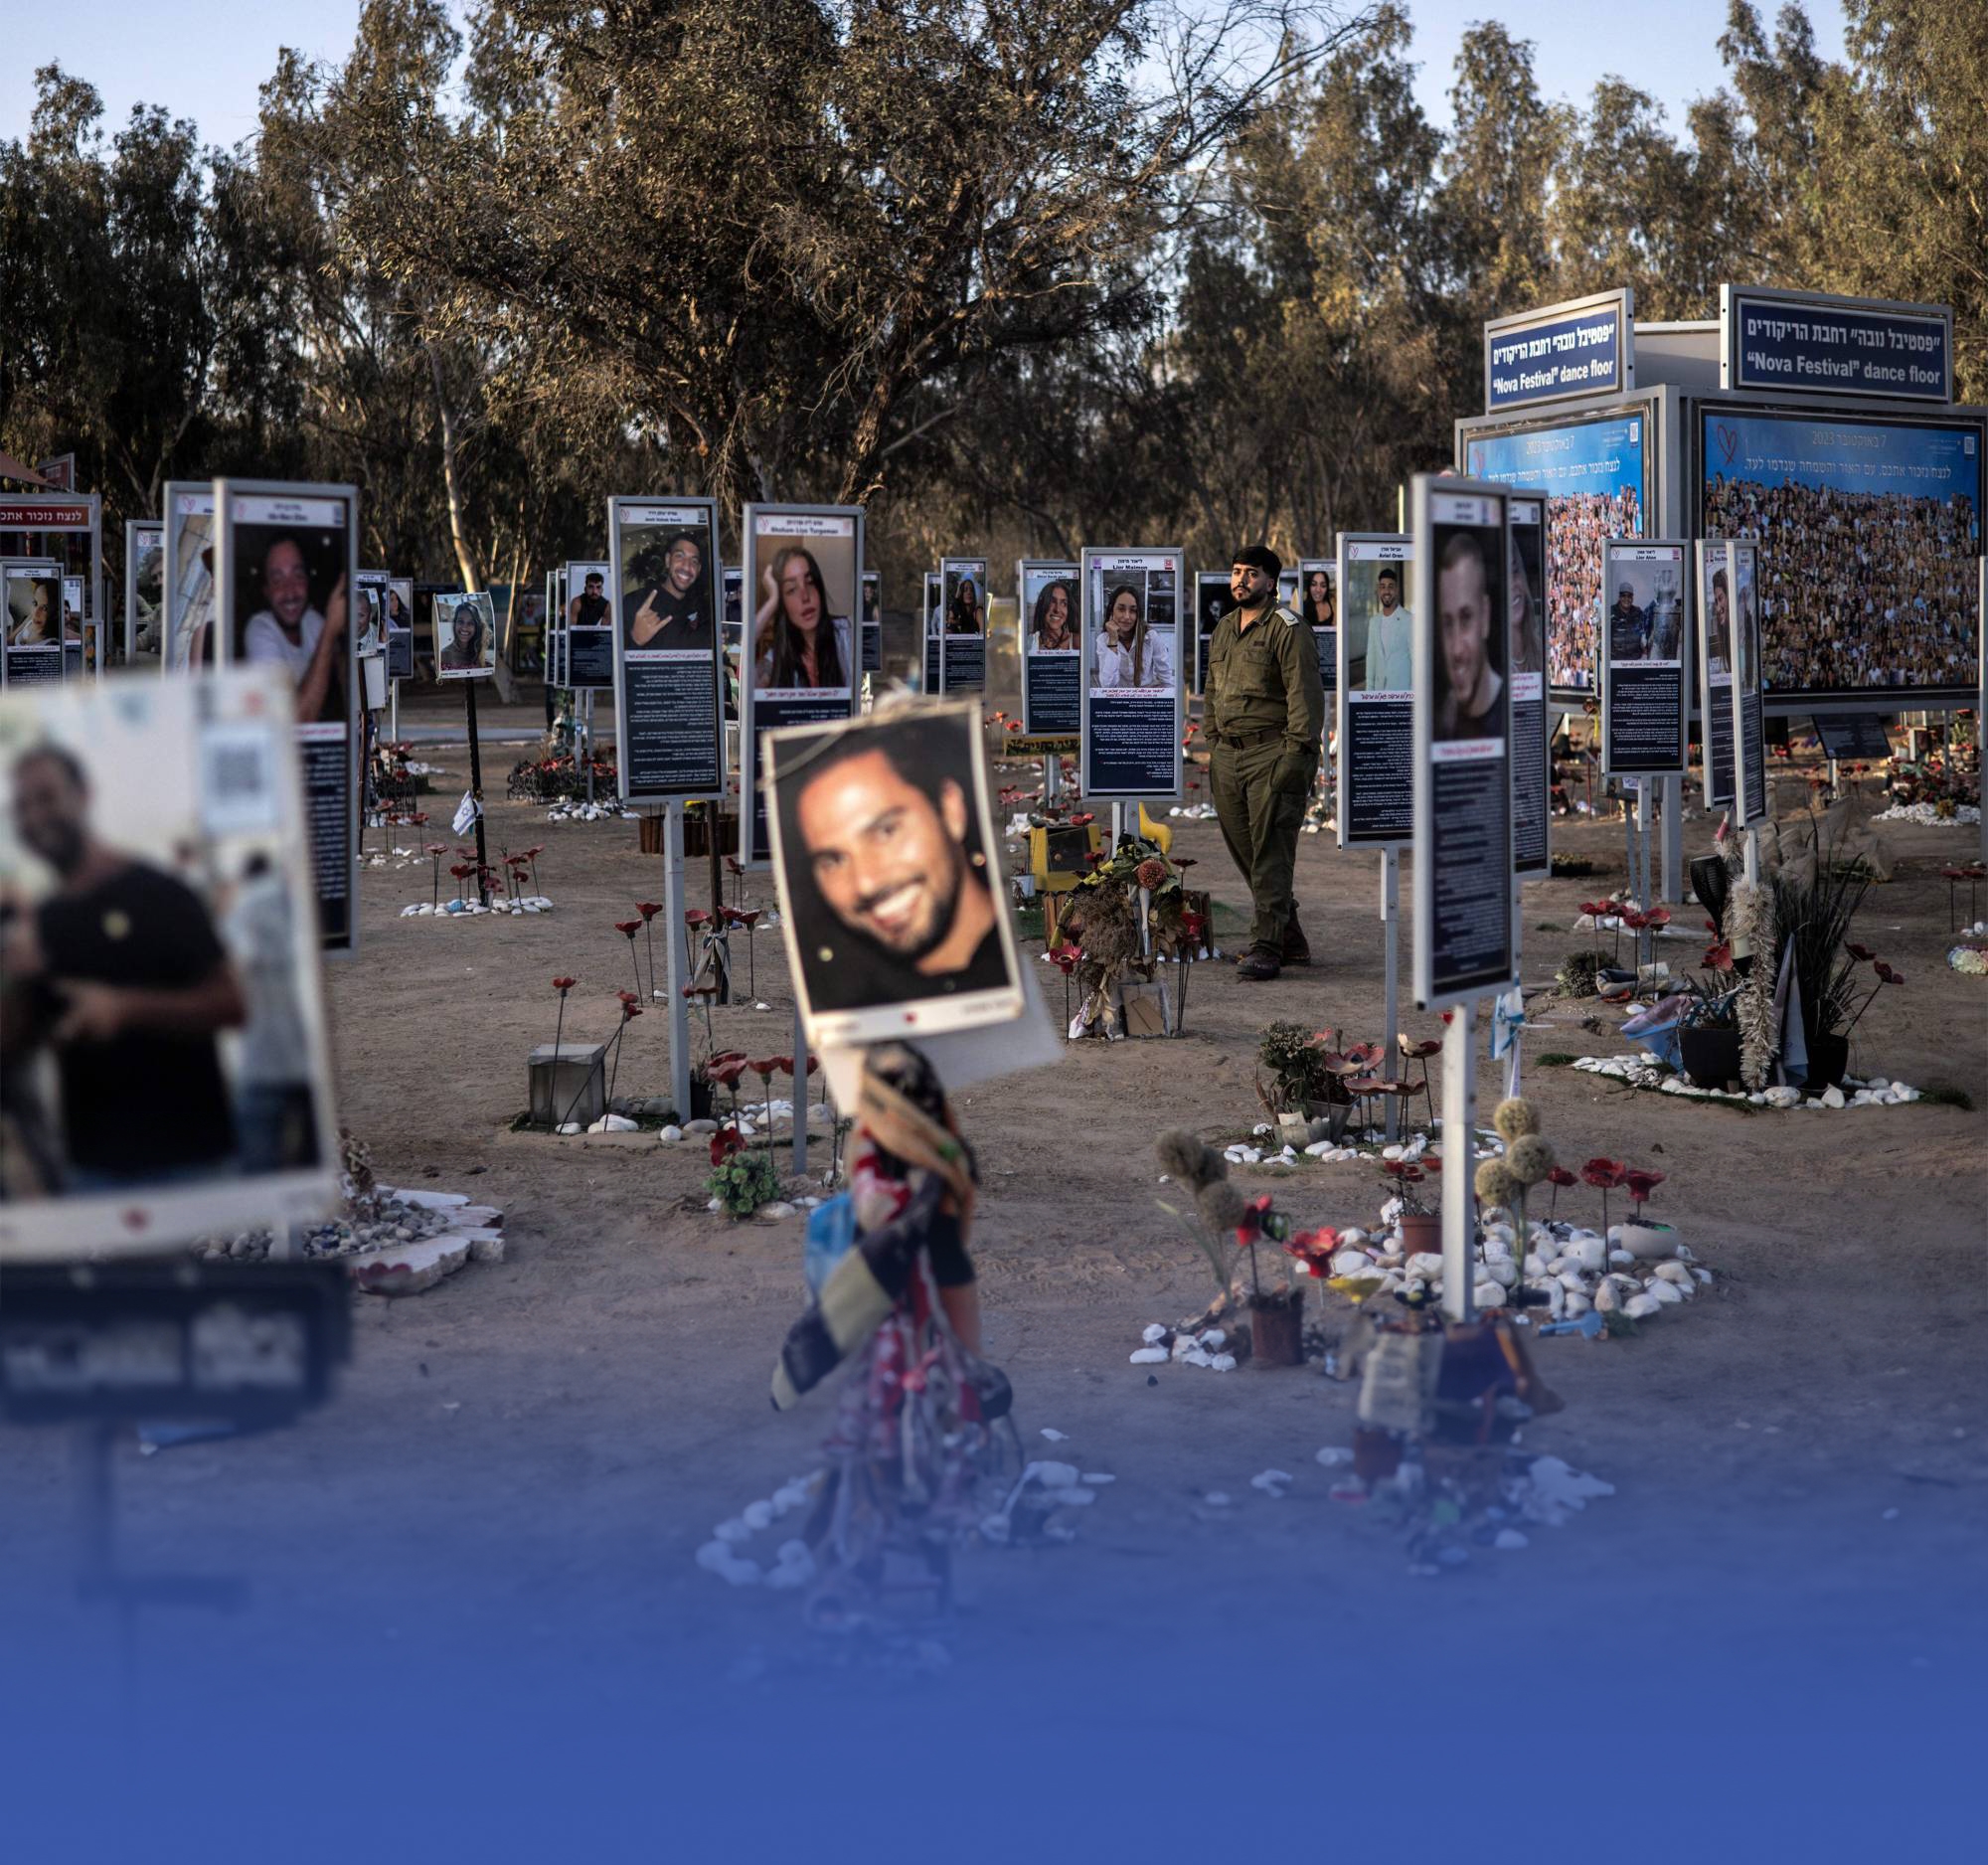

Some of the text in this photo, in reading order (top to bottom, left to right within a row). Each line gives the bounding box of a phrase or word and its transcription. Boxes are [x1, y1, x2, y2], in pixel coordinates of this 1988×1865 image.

[1747, 318, 1809, 342] הריקודים
[1812, 324, 1848, 344] רחבת
[1493, 342, 1529, 366] הריקודים
[1529, 337, 1552, 358] רחבת
[1493, 359, 1614, 395] “Nova Festival” dance floor
[1746, 351, 1941, 385] “Nova Festival” dance floor
[27, 512, 53, 521] נזכור
[57, 510, 82, 521] לנצח
